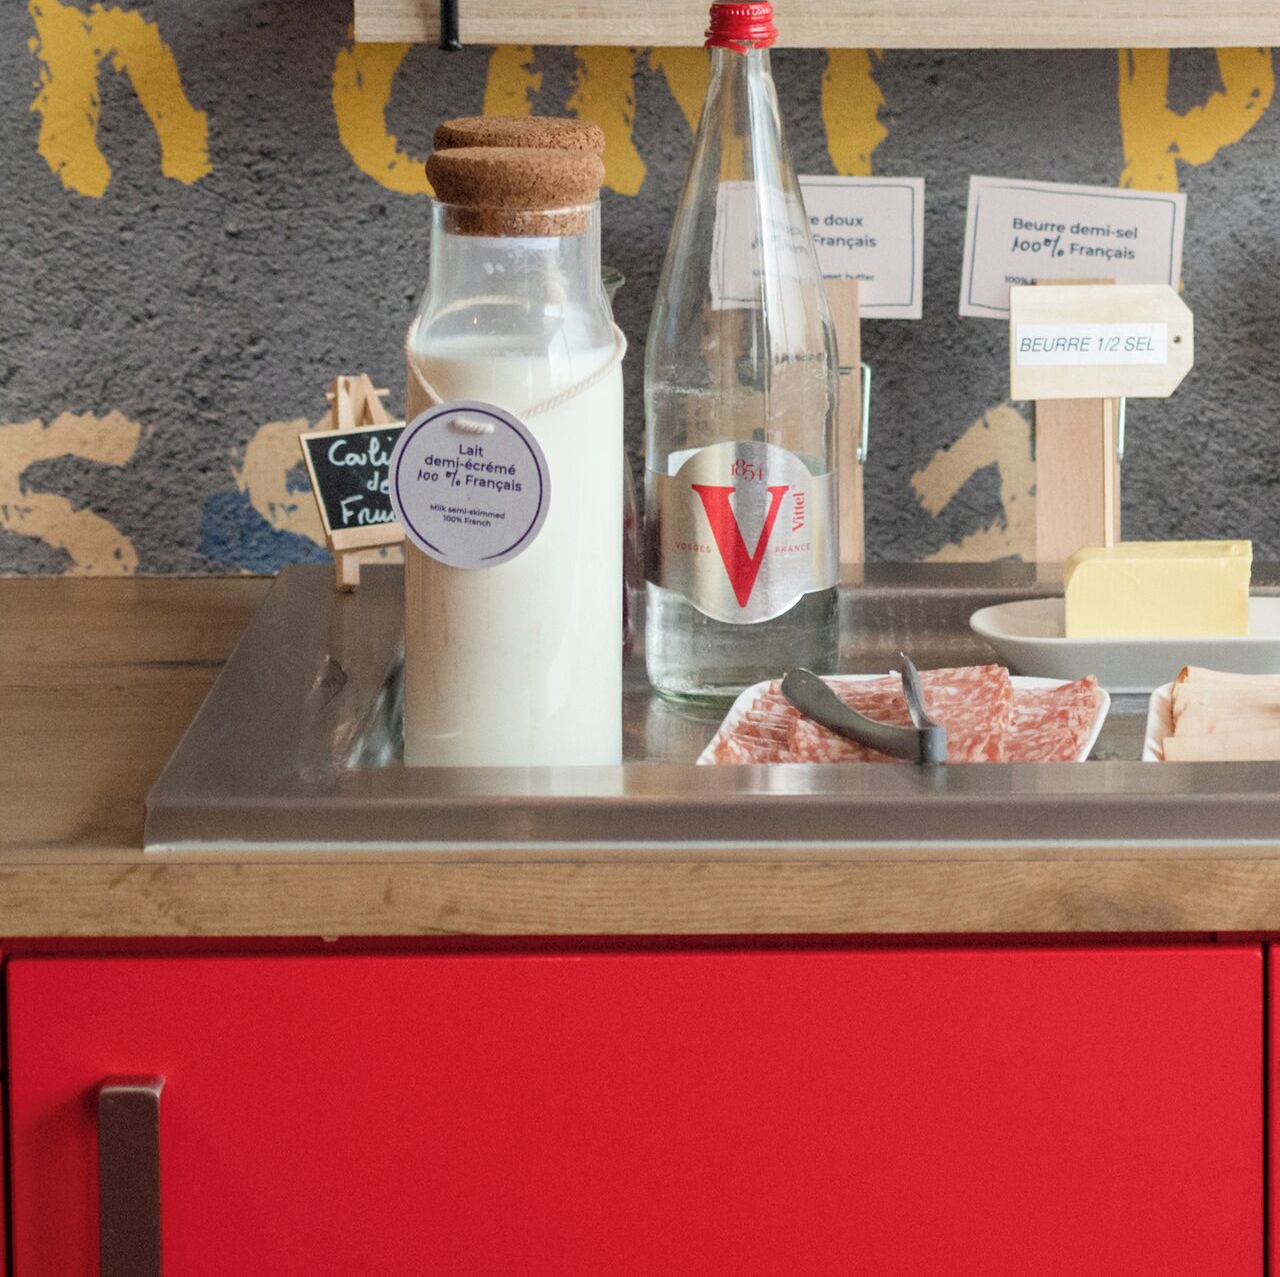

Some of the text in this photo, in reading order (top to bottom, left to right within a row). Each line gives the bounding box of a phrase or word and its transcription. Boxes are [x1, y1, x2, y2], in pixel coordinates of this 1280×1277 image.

[824, 214, 864, 227] doux
[1012, 217, 1138, 240] Beurre demi-sel
[1011, 234, 1136, 260] 100% Français
[1020, 336, 1156, 353] BEURRE 1/2 SEL
[328, 436, 391, 467] Couli
[458, 443, 484, 457] Lait
[424, 454, 516, 476] demi-écrémé
[465, 474, 523, 493] Français
[430, 503, 505, 520] Milk semi-skimmed
[792, 491, 805, 532] Vittel
[464, 516, 492, 528] French
[675, 540, 711, 553] VOSGES
[691, 484, 789, 608] V
[774, 541, 812, 553] FRANCE
